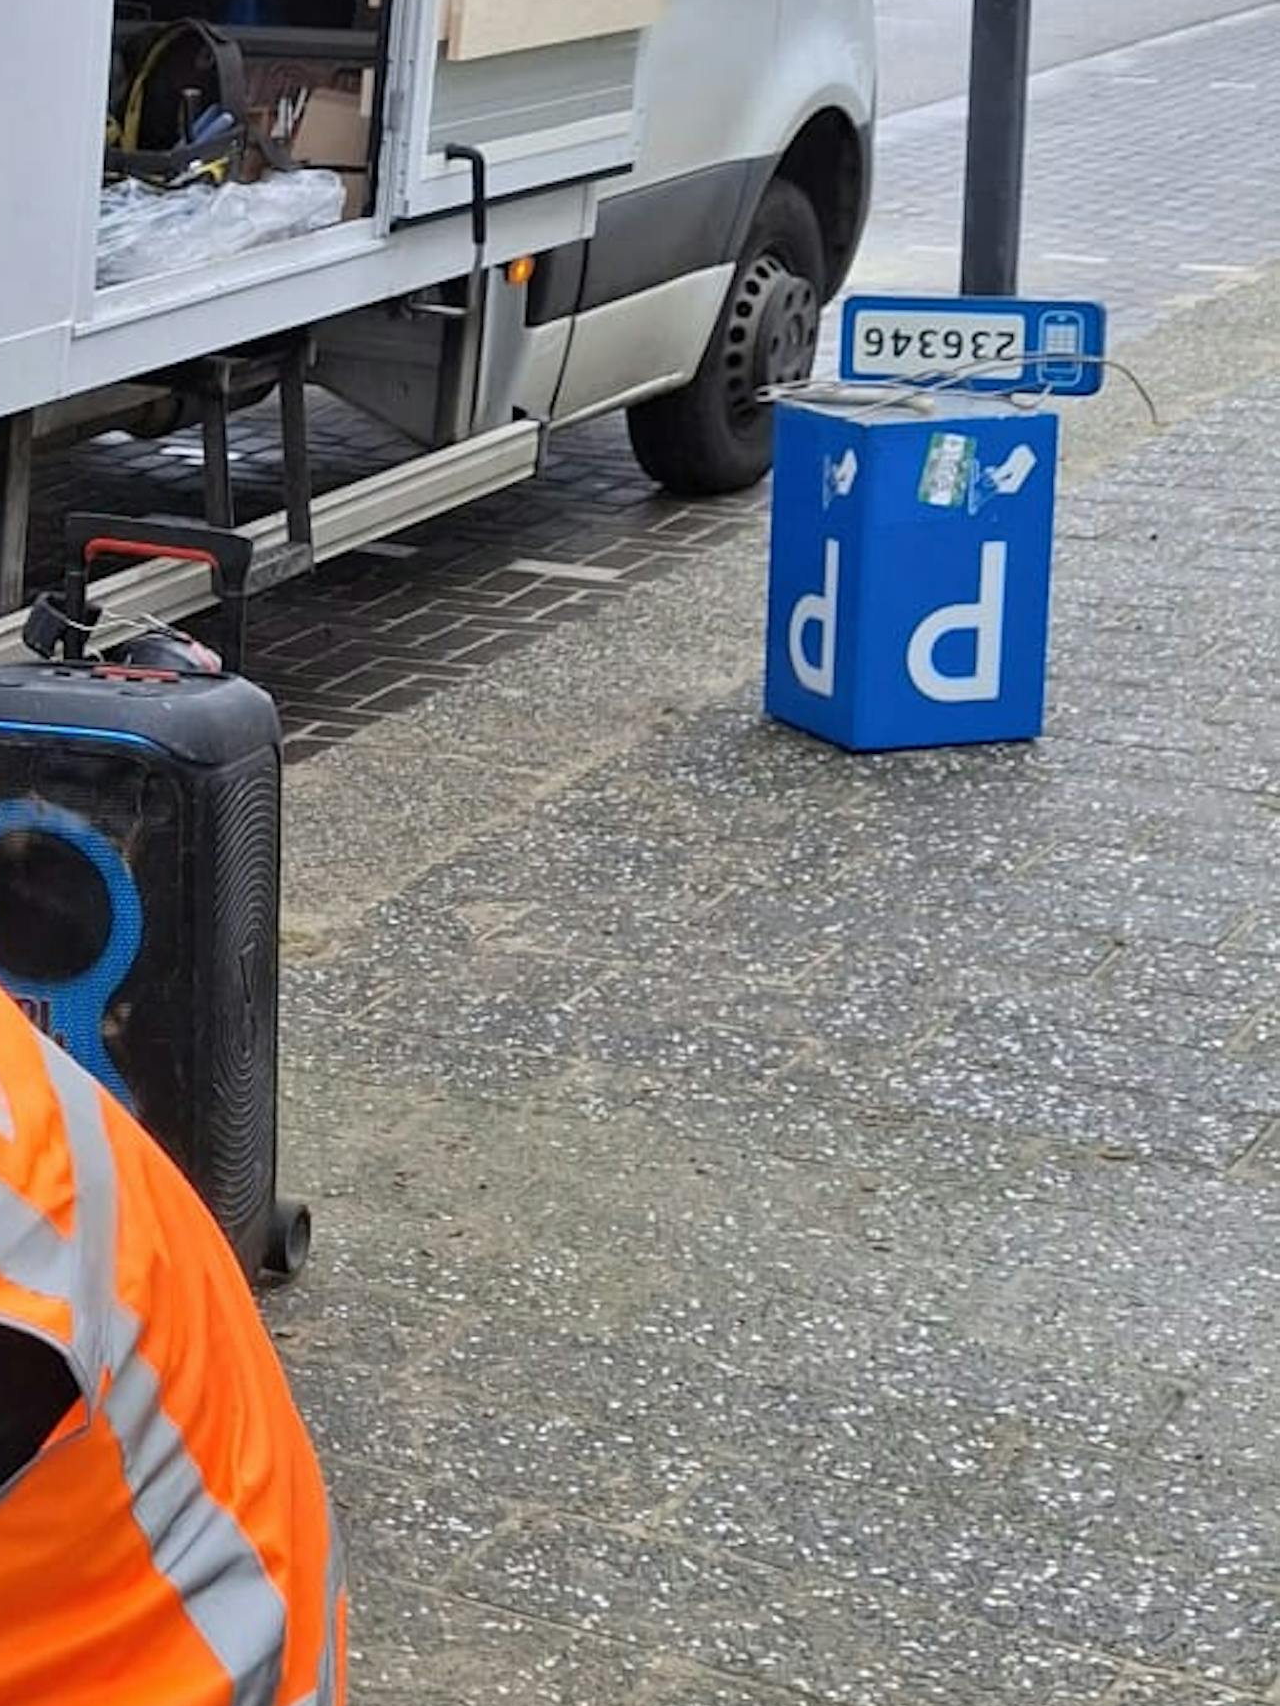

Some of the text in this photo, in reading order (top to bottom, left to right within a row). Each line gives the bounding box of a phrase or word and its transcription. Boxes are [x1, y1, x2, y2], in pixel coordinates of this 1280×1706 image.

[863, 327, 1016, 362] 236346
[789, 538, 839, 697] P
[907, 540, 1007, 702] P
